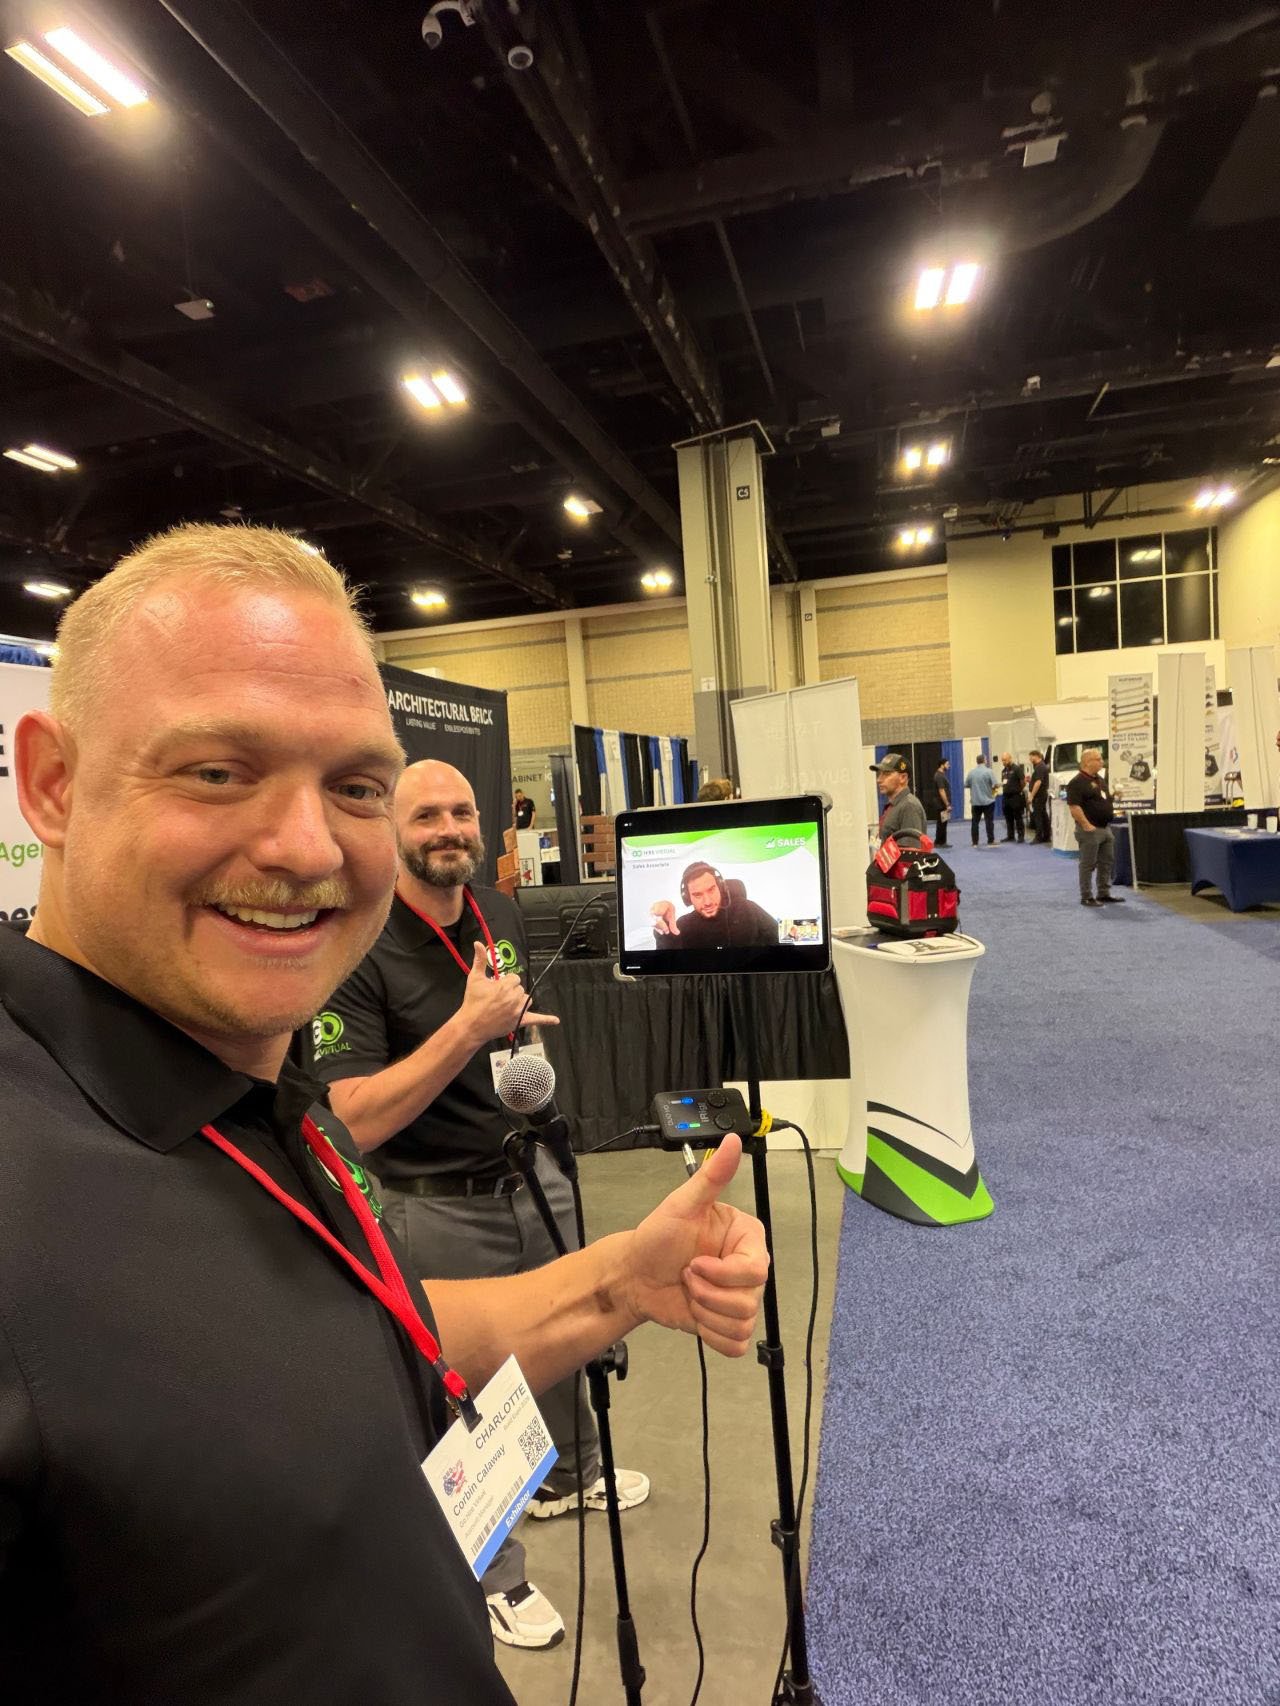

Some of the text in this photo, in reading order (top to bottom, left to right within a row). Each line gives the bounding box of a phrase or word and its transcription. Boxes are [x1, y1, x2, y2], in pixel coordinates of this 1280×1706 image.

[388, 689, 470, 722] ARCHITECTURAL
[512, 773, 542, 782] ABINET
[0, 842, 43, 867] Age
[777, 837, 806, 847] SALES
[475, 1383, 527, 1450] CHARLOTTE
[453, 1483, 478, 1517] Corbin
[476, 1443, 506, 1484] Calaway
[504, 1489, 531, 1527] Exhibitor
